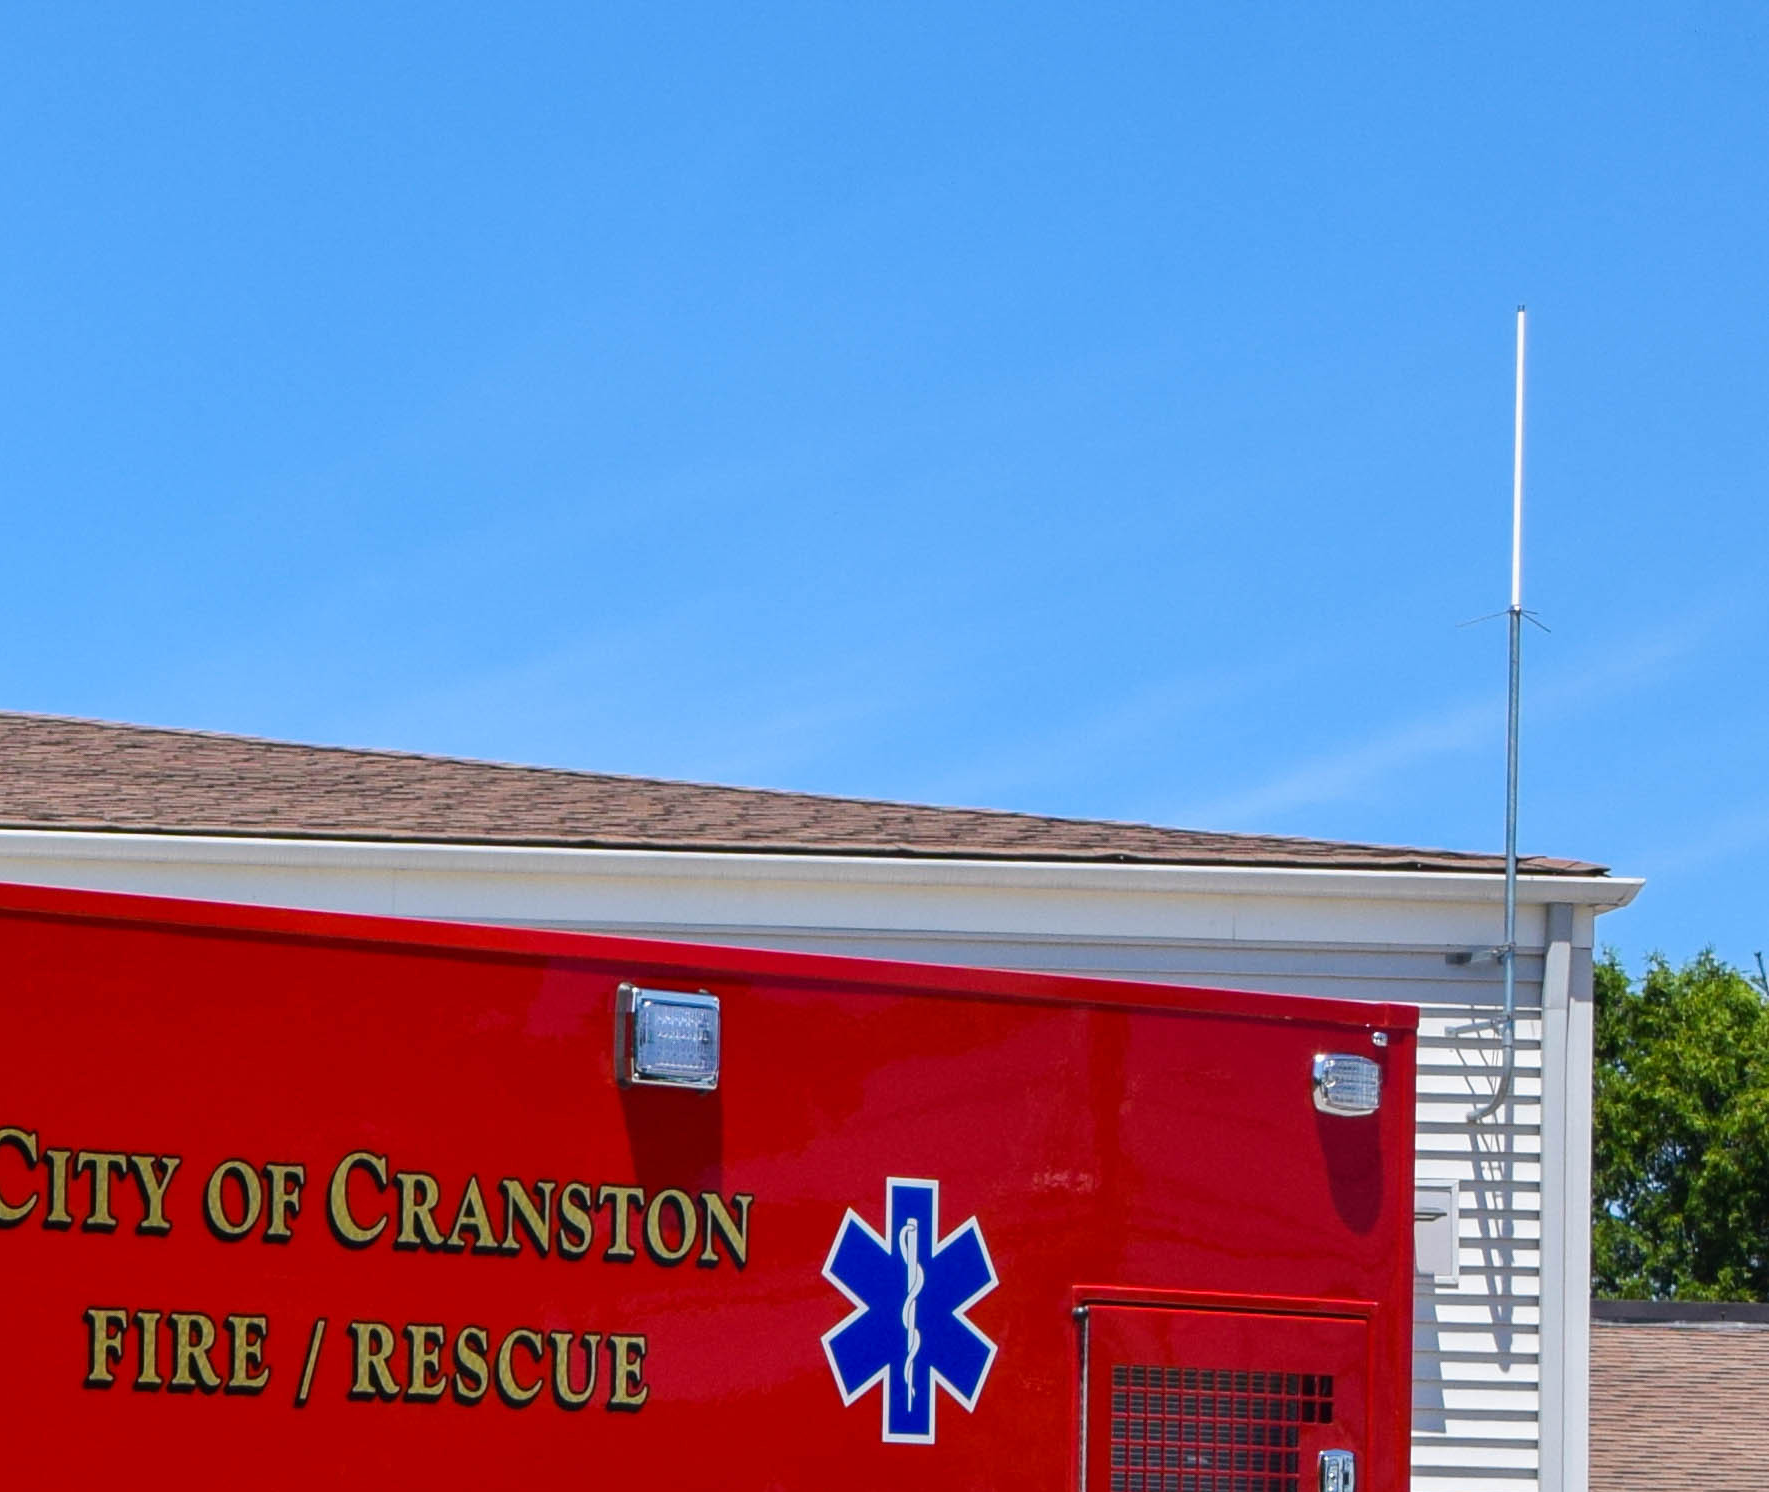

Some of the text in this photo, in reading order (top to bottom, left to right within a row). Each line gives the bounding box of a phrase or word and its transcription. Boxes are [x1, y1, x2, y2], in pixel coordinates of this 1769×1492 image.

[326, 1150, 753, 1270] CRANSTON
[83, 1306, 270, 1397] FIRE
[346, 1320, 651, 1415] RESCUE
